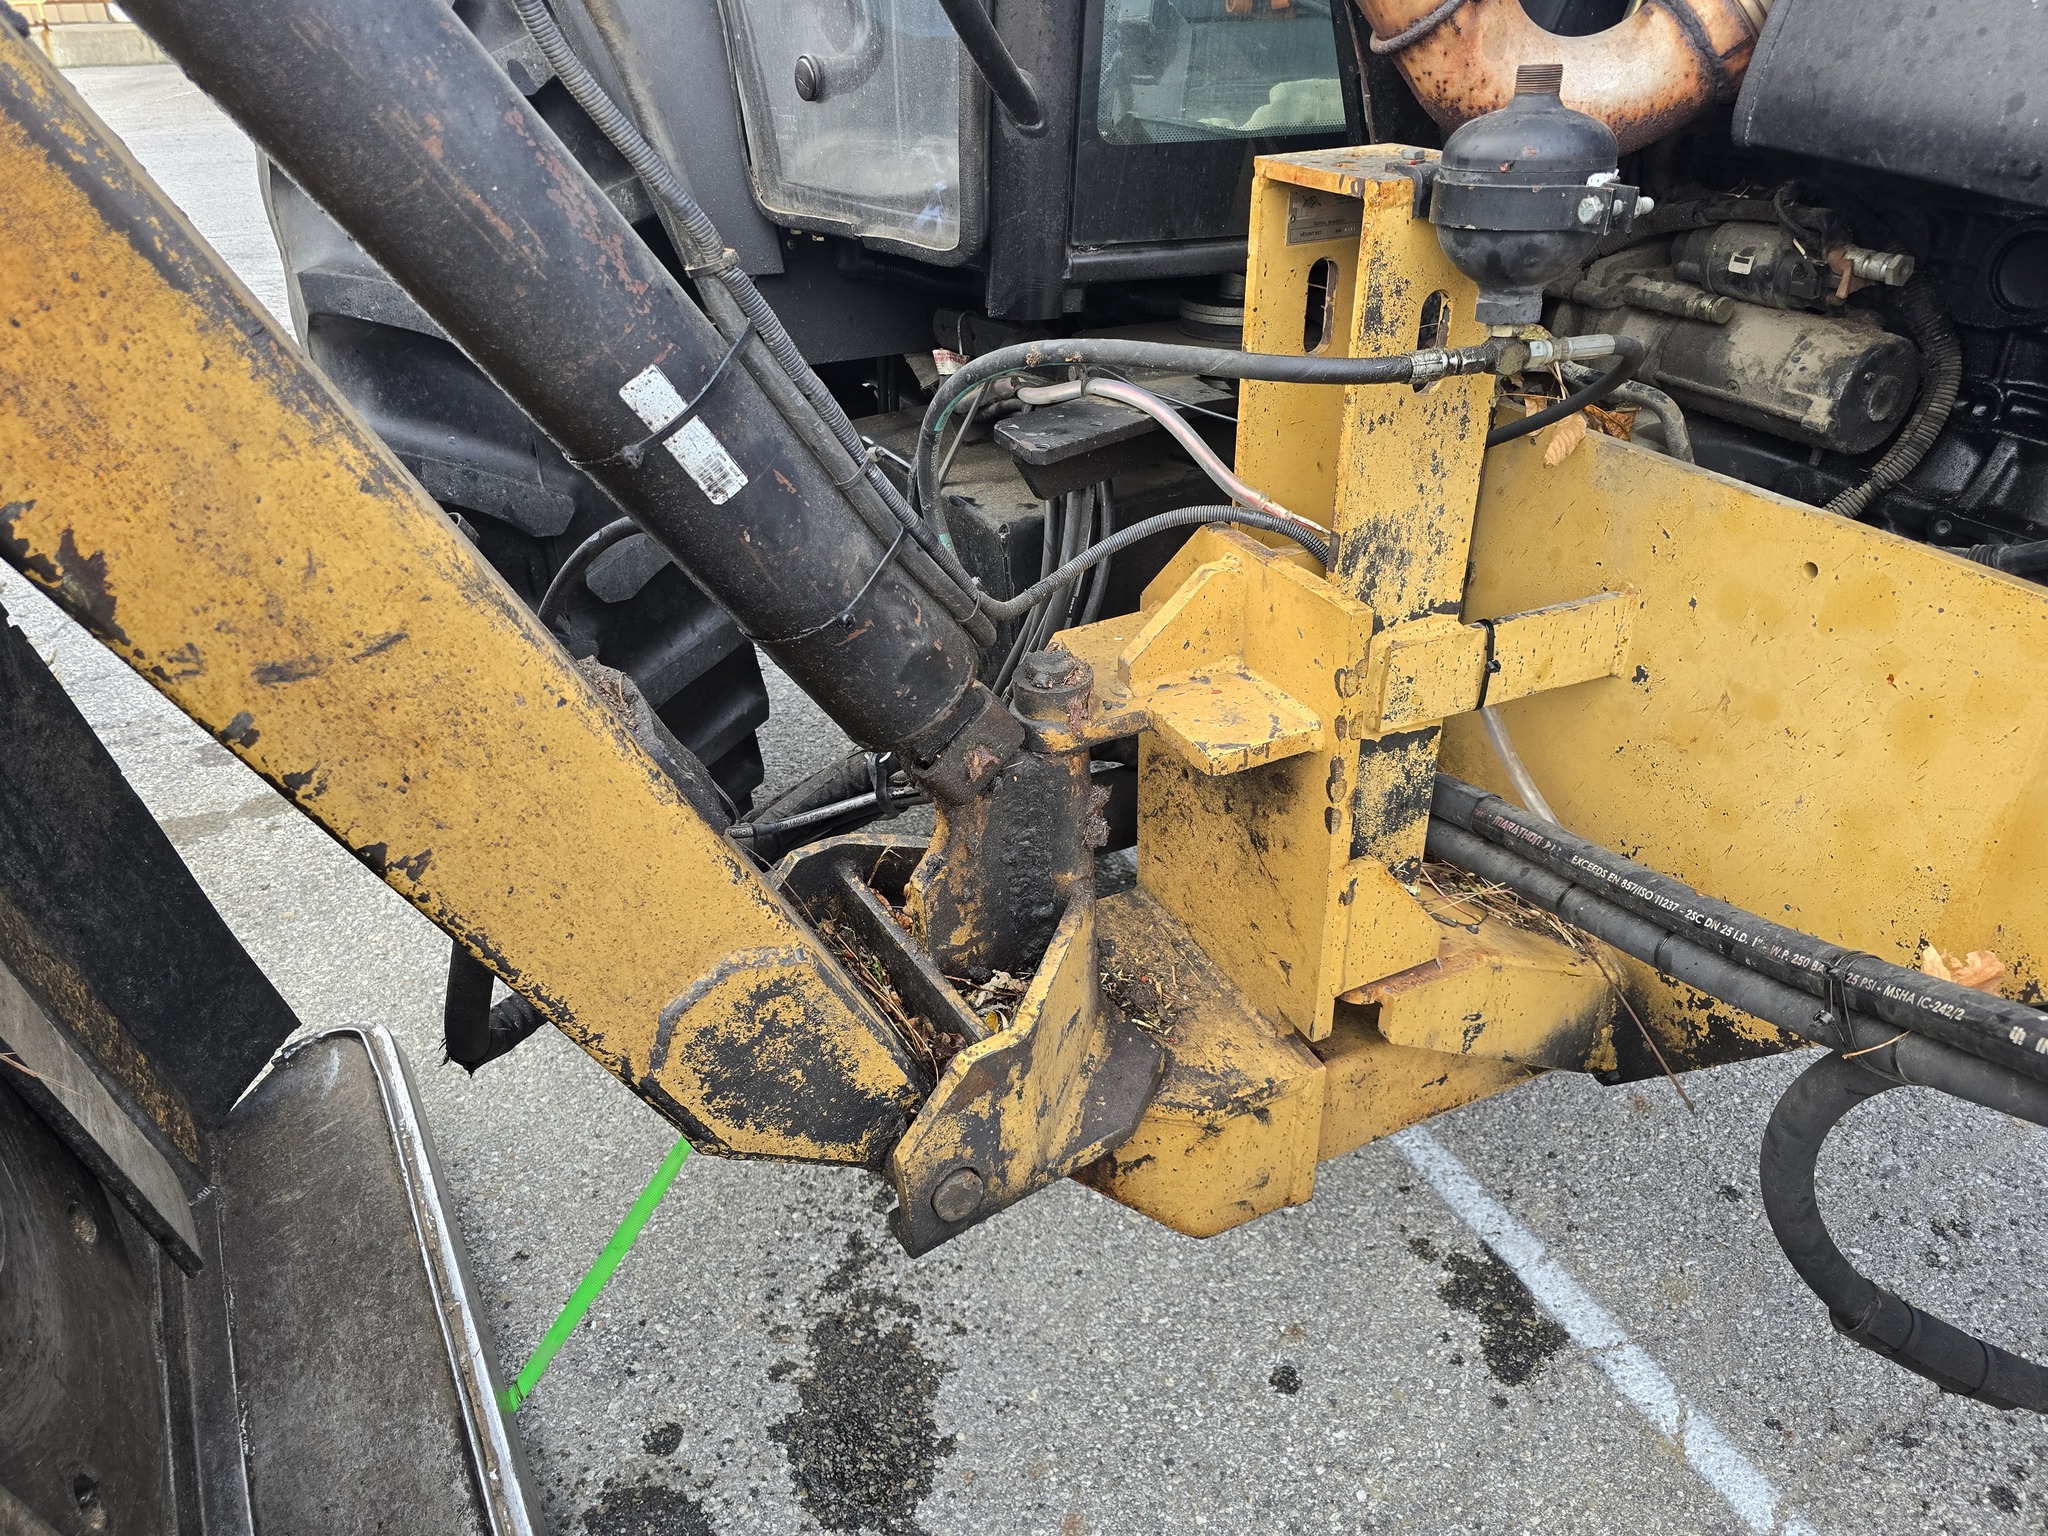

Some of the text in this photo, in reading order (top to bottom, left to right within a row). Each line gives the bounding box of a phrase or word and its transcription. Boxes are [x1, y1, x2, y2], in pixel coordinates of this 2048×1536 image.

[1492, 815, 1543, 846] MARATHON
[1570, 854, 1608, 879] EXCEEDS
[1607, 872, 1621, 886] EN
[1620, 877, 1654, 902] 857/ISO
[1653, 892, 1680, 912] 11237
[1685, 909, 1705, 925] 2SC
[1703, 917, 1721, 932] DN
[1720, 924, 1733, 937] 25
[1732, 929, 1748, 944] I.D.
[1769, 944, 1790, 961] W.P.
[1791, 953, 1812, 968] 250
[1811, 960, 1826, 973] BA
[1859, 977, 1876, 992] PSI
[1883, 985, 1916, 1006] MSHA
[1916, 995, 1966, 1021] IC-242/2
